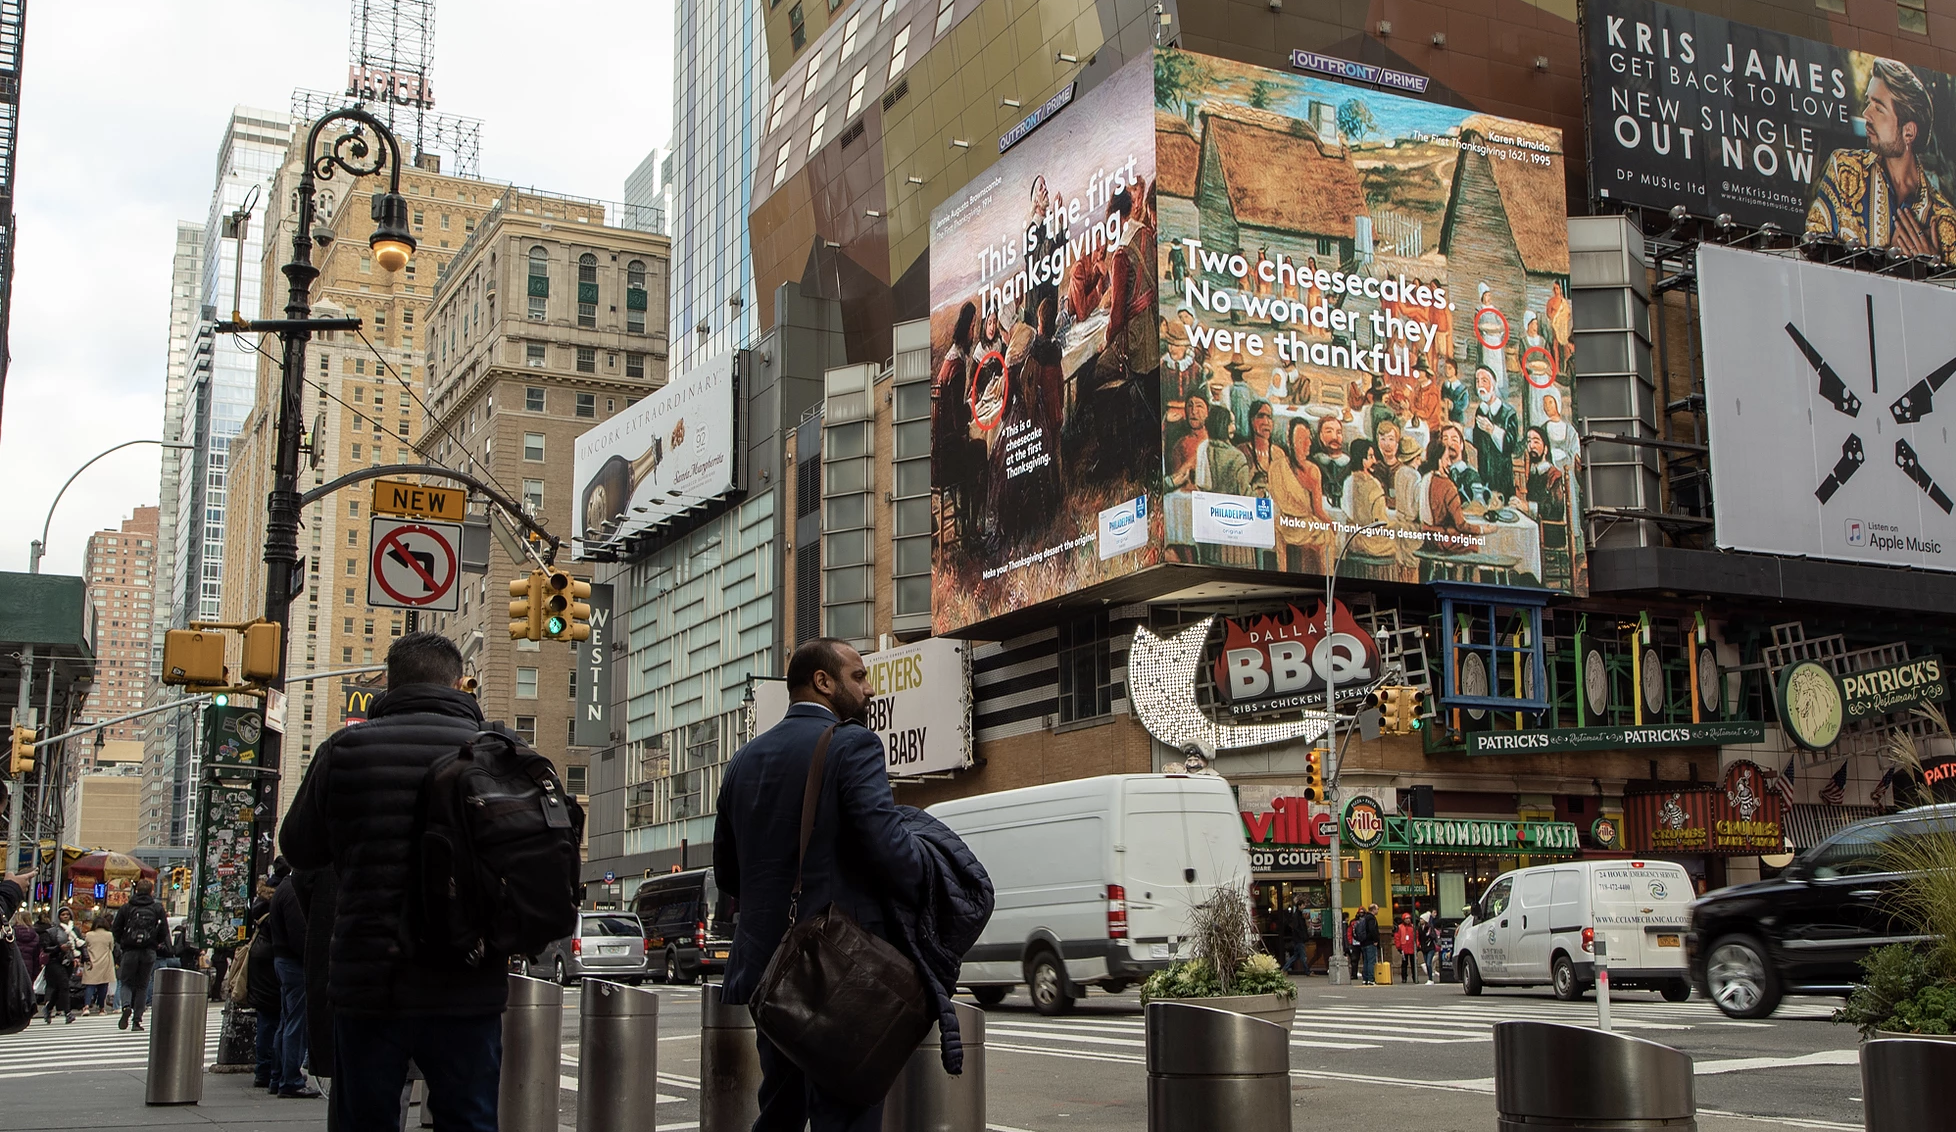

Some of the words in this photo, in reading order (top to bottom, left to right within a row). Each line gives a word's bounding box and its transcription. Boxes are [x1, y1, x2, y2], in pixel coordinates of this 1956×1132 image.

[1297, 53, 1375, 80] OUTFRONT
[1385, 72, 1423, 90] PRIME
[1606, 14, 1695, 64] KRIS
[1721, 43, 1846, 99] JAMES
[348, 65, 435, 103] HOTEL
[1609, 52, 1654, 79] GET
[1669, 65, 1735, 98] BACK
[1747, 83, 1776, 106] TO
[1790, 93, 1848, 123] LOVE
[1000, 109, 1042, 149] OUTFRONT
[1046, 87, 1071, 114] PRIME
[1611, 86, 1680, 124] NEW
[1701, 105, 1813, 153] SINGLE
[1413, 130, 1429, 142] The
[1430, 134, 1450, 147] First
[1451, 137, 1506, 160] Thanksgiving
[1508, 149, 1529, 163] 1621,
[1530, 153, 1551, 166] 1995
[1488, 131, 1515, 145] Karen
[1517, 136, 1551, 153] Rinaldo
[1614, 114, 1694, 160] OUT
[1721, 136, 1814, 184] NOW
[1616, 168, 1634, 181] DP
[1687, 181, 1705, 195] ltd
[1721, 180, 1803, 207] @MrKrisJames
[978, 234, 1017, 282] This
[1022, 220, 1038, 256] is
[1043, 195, 1080, 239] the
[1086, 153, 1138, 213] first
[977, 210, 1129, 320] Thanksgiving.
[1183, 238, 1248, 278] Two
[1258, 253, 1456, 312] cheesecakes.
[1185, 277, 1231, 314] No
[1241, 298, 1360, 333] wonder
[1369, 308, 1438, 353] they
[1184, 323, 1264, 357] were
[1274, 331, 1420, 380] thankful.
[696, 431, 706, 449] 92
[1005, 427, 1043, 452] cheesecake
[1019, 420, 1026, 433] is
[1026, 419, 1031, 428] a
[580, 426, 621, 460] UNCORK
[1005, 453, 1014, 466] at
[1015, 449, 1027, 461] the
[1027, 441, 1042, 456] first
[1005, 453, 1051, 480] Thanksgiving.
[393, 488, 446, 513] NEW
[1210, 506, 1254, 521] PHILADELPHIA
[1279, 516, 1307, 529] Make
[1308, 521, 1330, 533] your
[1332, 521, 1395, 539] Thanksgiving
[1397, 528, 1431, 541] dessert
[1433, 532, 1449, 543] the
[1451, 534, 1486, 549] original
[1868, 521, 1888, 531] Listen
[982, 568, 996, 580] Make
[997, 563, 1009, 578] your
[1008, 551, 1043, 570] Thanksgiving
[1043, 544, 1064, 558] dessert
[1064, 539, 1074, 550] the
[1074, 530, 1097, 547] original
[1869, 533, 1904, 552] Apple
[1906, 536, 1942, 554] Music
[1250, 620, 1331, 644] DALLAS
[587, 608, 610, 721] WESTIN
[865, 653, 923, 697] MEYERS
[1226, 632, 1372, 700] BBQ
[1842, 660, 1941, 701] PATRICK'S
[867, 696, 895, 732] BBY
[1233, 703, 1258, 715] RIBS
[1270, 694, 1322, 709] CHICKEN
[889, 727, 927, 766] BABY
[1478, 734, 1549, 750] PATRICK'S
[1624, 729, 1690, 743] PATRICK'S
[1346, 812, 1382, 831] villa
[1413, 820, 1509, 848] STROMBOLI
[1535, 826, 1581, 849] PASTA
[1651, 827, 1706, 840] CRUMBS
[1716, 820, 1779, 836] CRUMBS
[1607, 870, 1629, 878] HOUR
